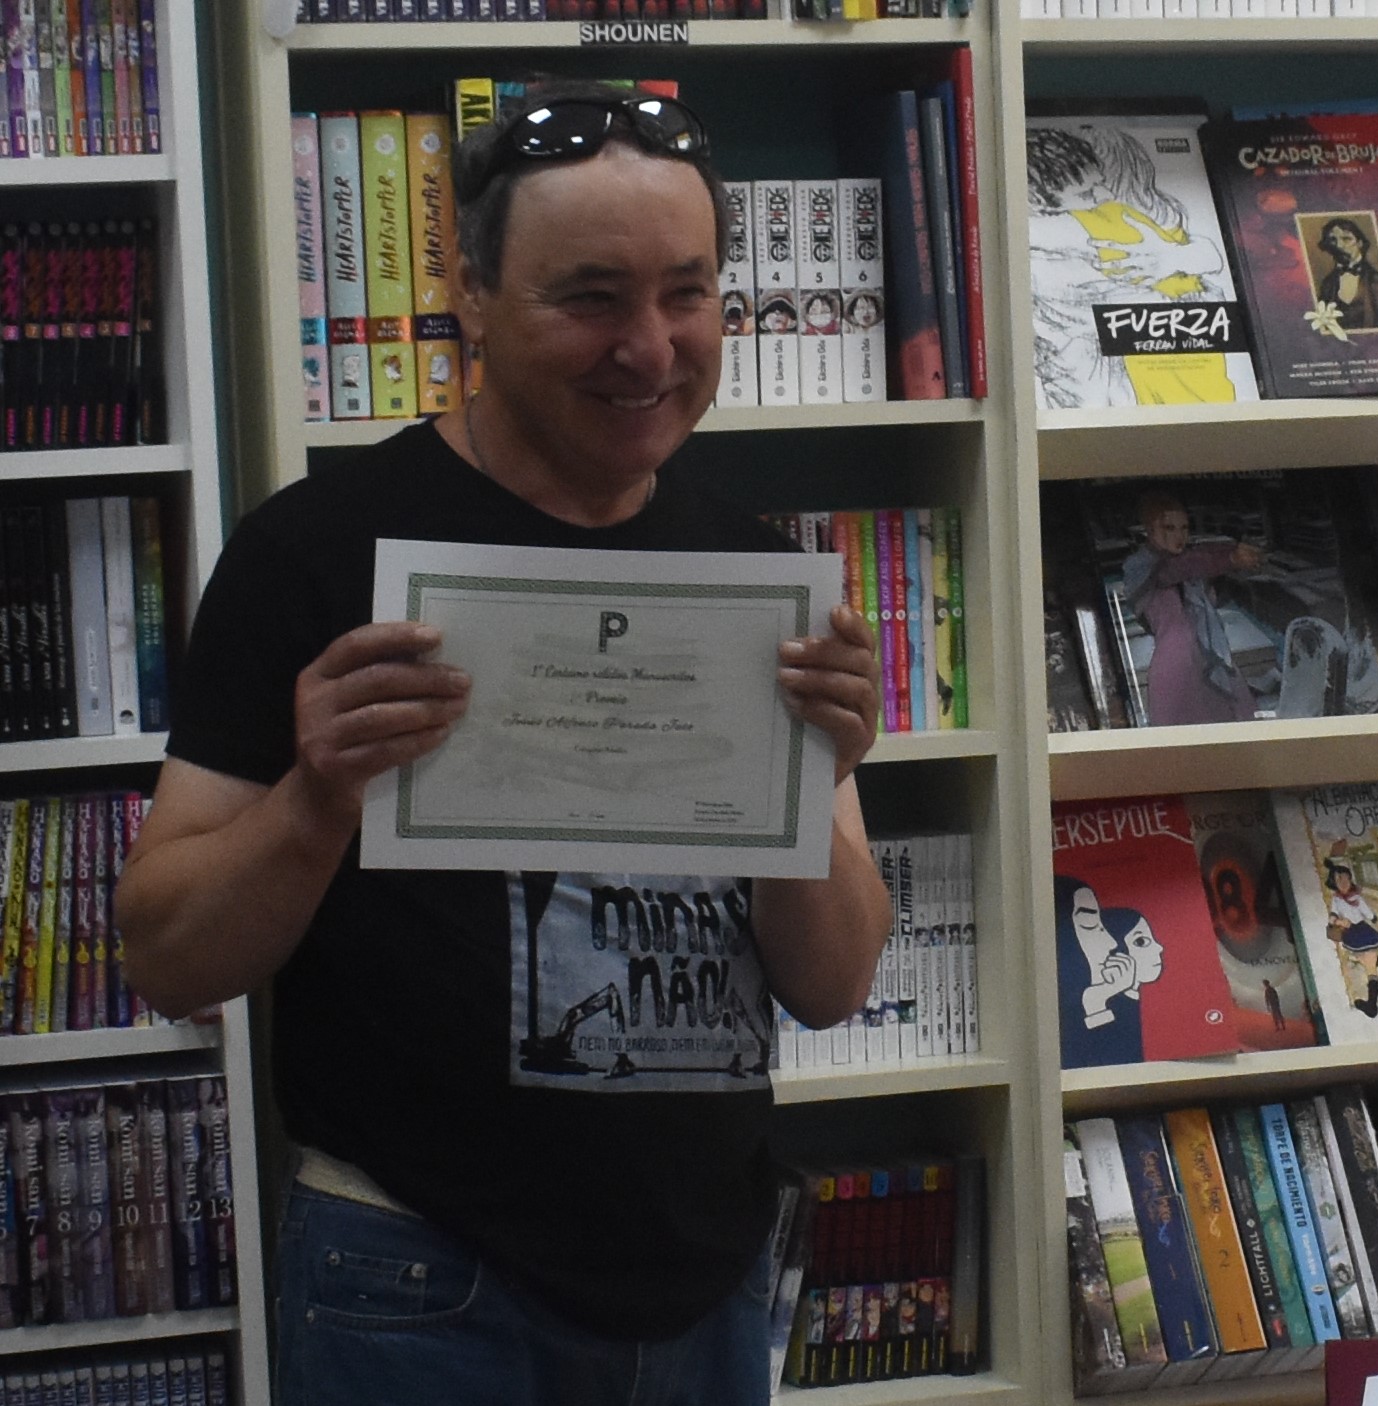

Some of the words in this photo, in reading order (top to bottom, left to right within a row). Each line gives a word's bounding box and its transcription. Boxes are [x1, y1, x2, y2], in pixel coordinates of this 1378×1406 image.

[580, 23, 688, 43] SHOUNEN
[1238, 146, 1328, 169] CAZADOR
[729, 271, 737, 284] 2
[771, 271, 780, 282] 4
[816, 272, 823, 284] 5
[859, 271, 867, 283] 6
[1103, 306, 1231, 342] FUERZA
[1271, 1118, 1287, 1149] TORPE
[1279, 1152, 1291, 1163] DE
[1283, 1166, 1308, 1228] NACIMIENTO
[117, 1204, 140, 1227] 10
[180, 1199, 201, 1222] 12
[210, 1197, 232, 1220] 13
[27, 1215, 38, 1237] 7
[57, 1211, 71, 1232] 8
[1250, 1231, 1273, 1297] LIGHTFALL
